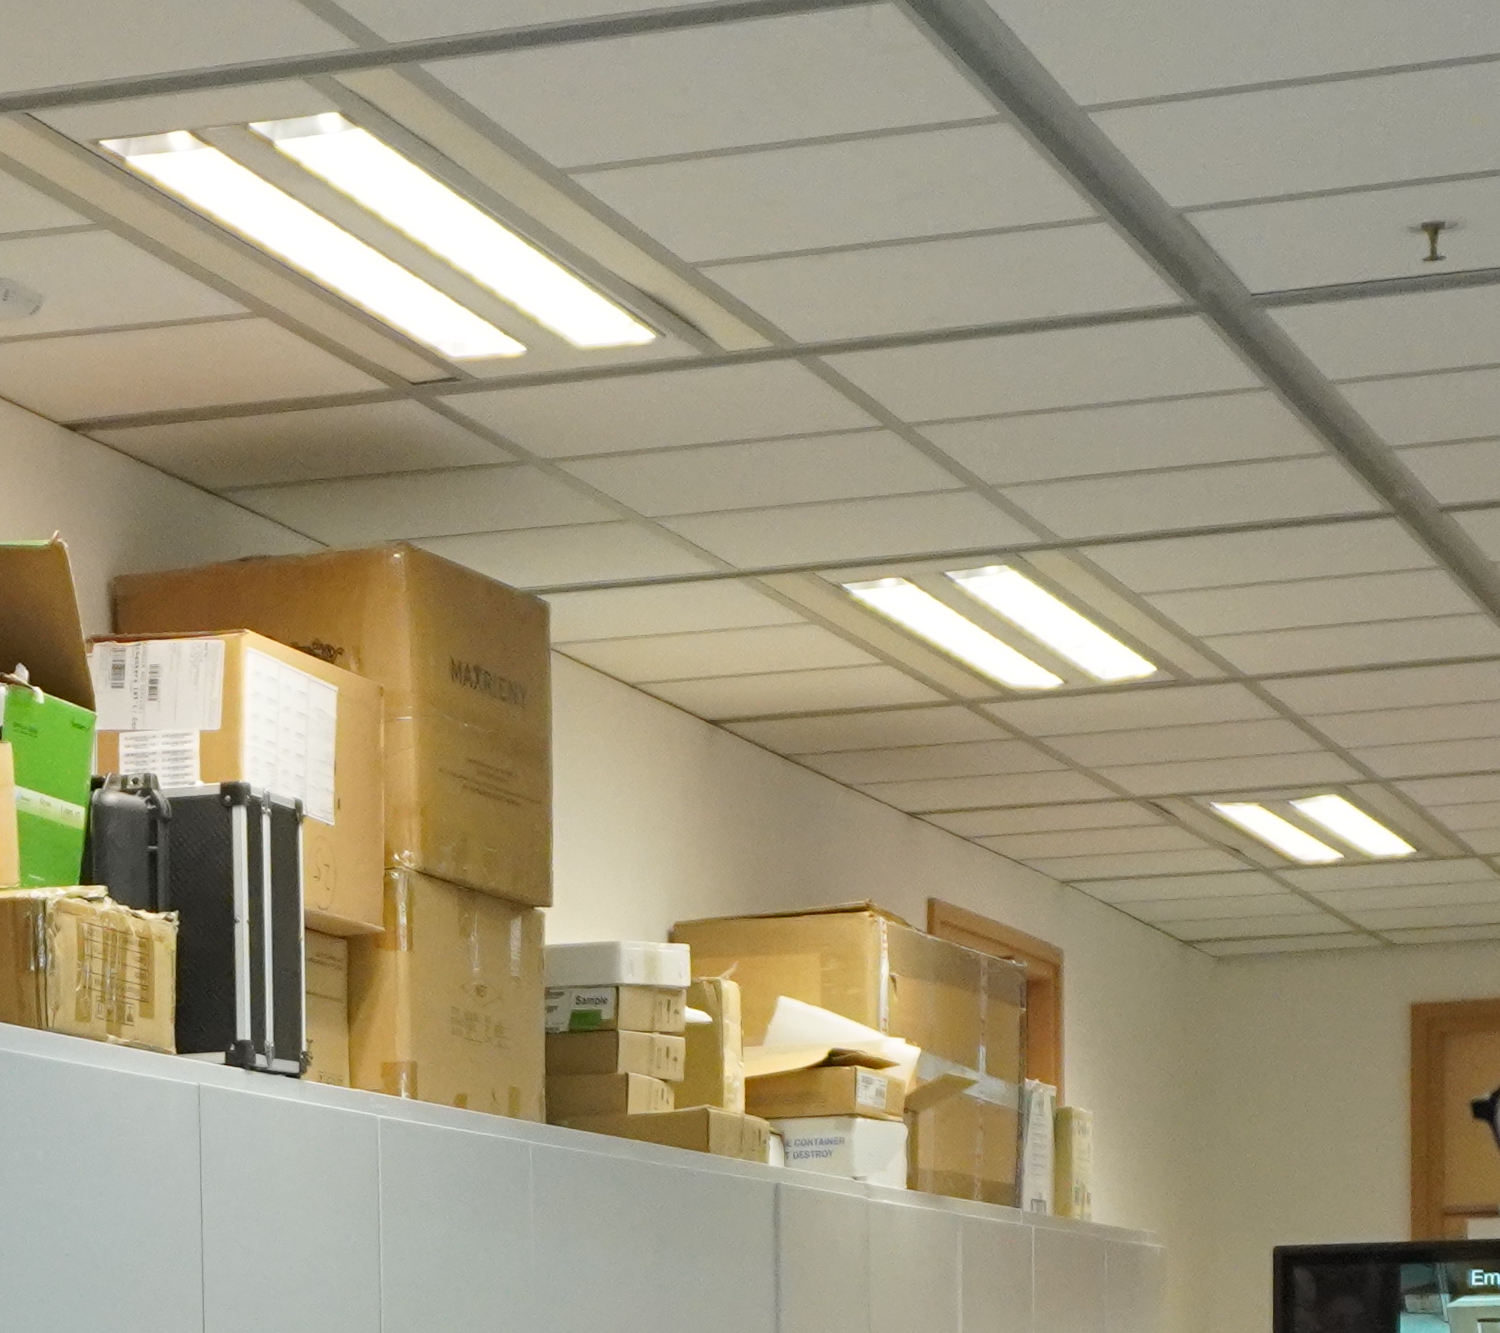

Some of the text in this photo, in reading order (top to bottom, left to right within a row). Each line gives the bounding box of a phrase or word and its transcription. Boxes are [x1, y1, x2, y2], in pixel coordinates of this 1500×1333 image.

[575, 995, 609, 1006] Sample
[794, 1137, 845, 1148] CONTAINER
[793, 1150, 833, 1160] DESTROY
